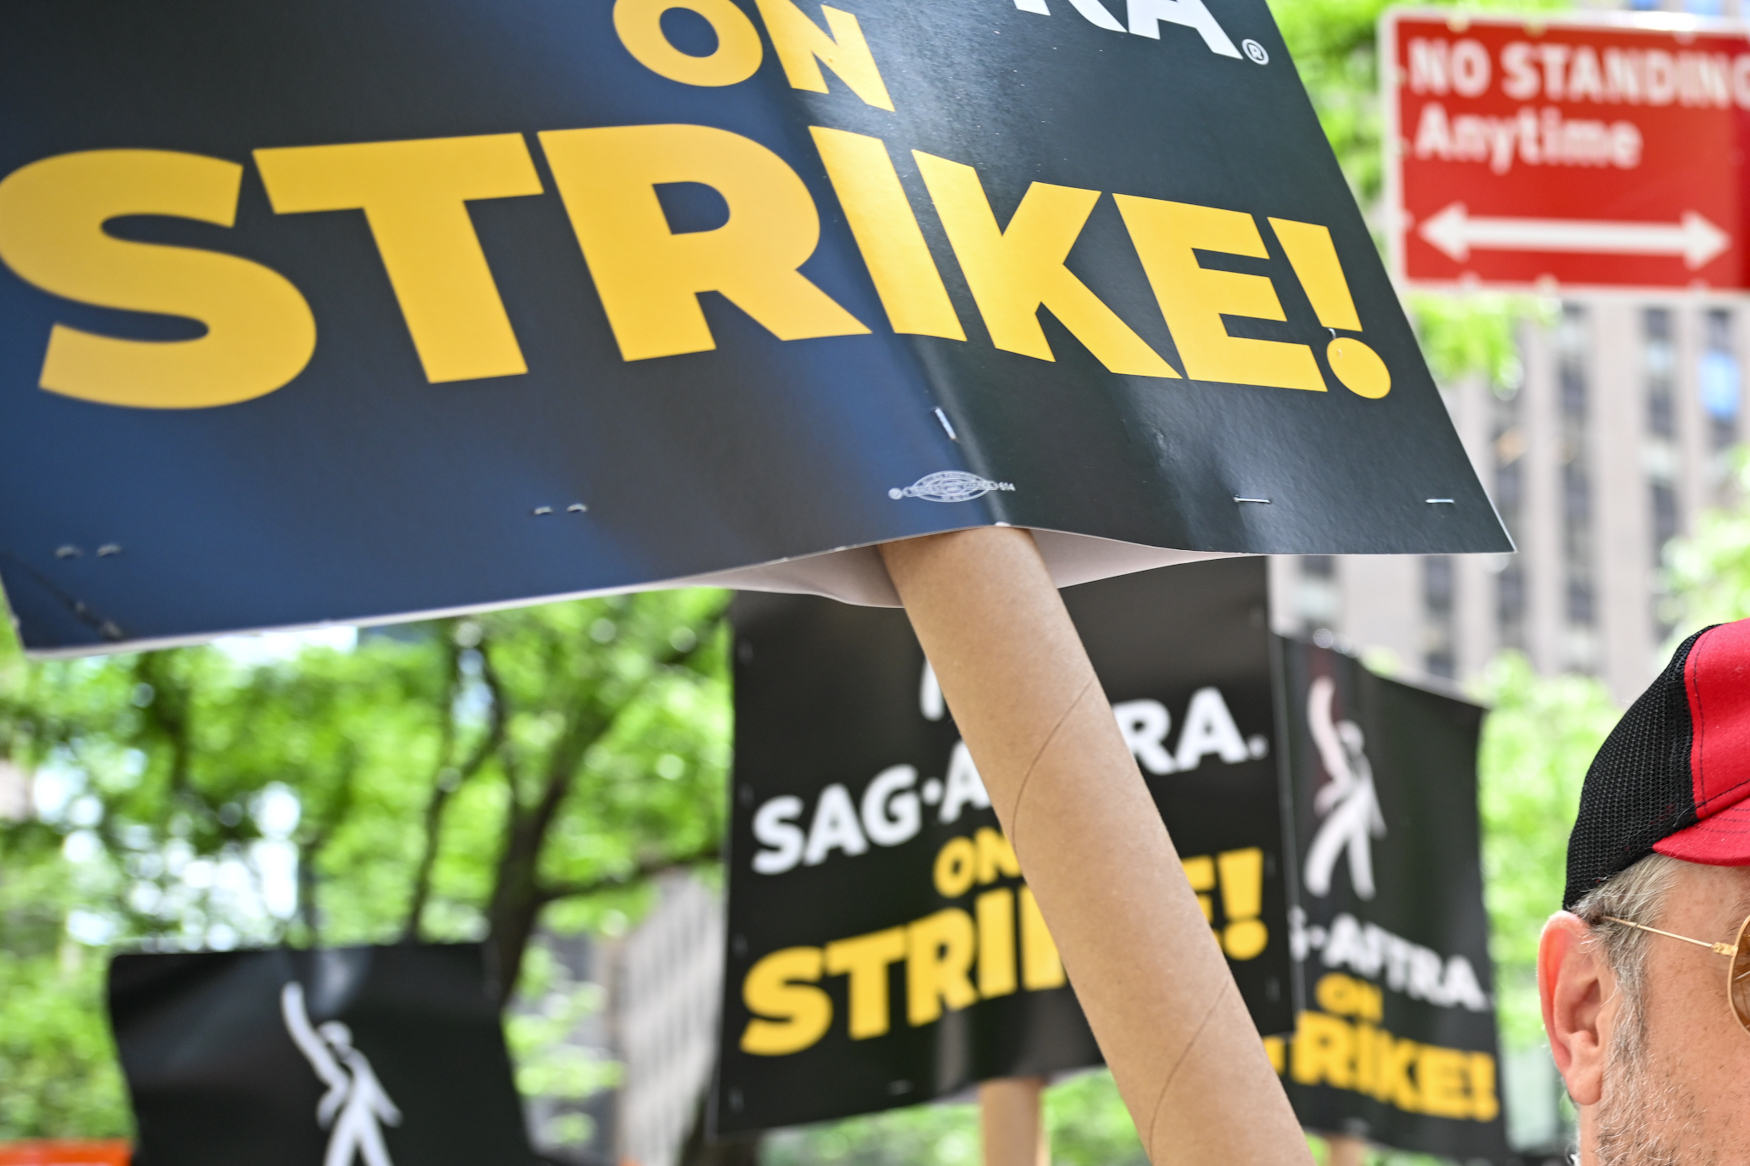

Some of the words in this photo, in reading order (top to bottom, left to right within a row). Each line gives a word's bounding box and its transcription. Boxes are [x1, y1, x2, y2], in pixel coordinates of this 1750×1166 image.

[612, 0, 896, 112] ON
[1408, 37, 1492, 98] NO
[1414, 102, 1643, 176] Anytime
[0, 123, 1392, 409] STRIKE!
[1314, 971, 1385, 1024] ON
